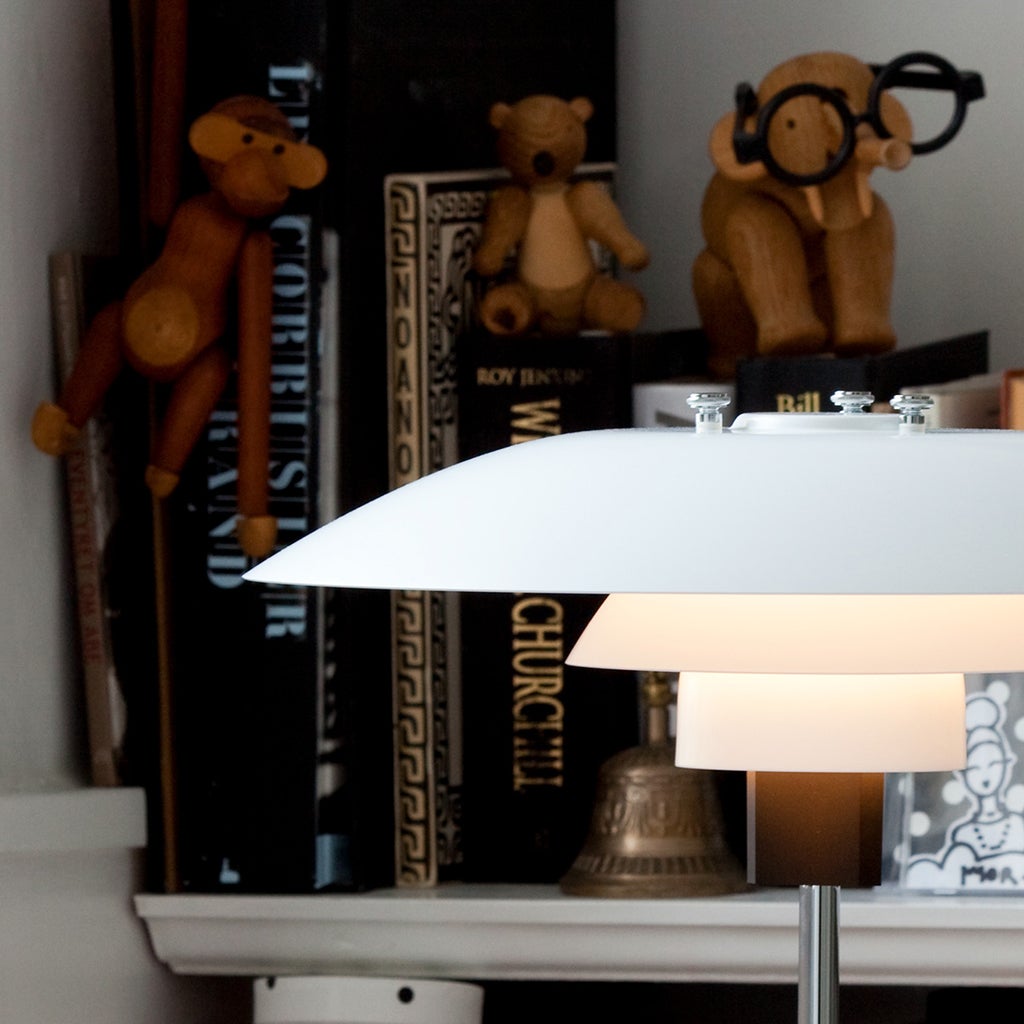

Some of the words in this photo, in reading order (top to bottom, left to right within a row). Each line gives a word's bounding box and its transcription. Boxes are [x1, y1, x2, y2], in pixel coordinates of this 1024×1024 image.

[264, 214, 311, 641] CORBUSIR
[477, 367, 515, 385] ROY
[520, 367, 591, 385] JENKIN
[777, 392, 821, 413] Bill
[207, 410, 247, 589] RAND
[511, 596, 565, 791] CHURCHILL
